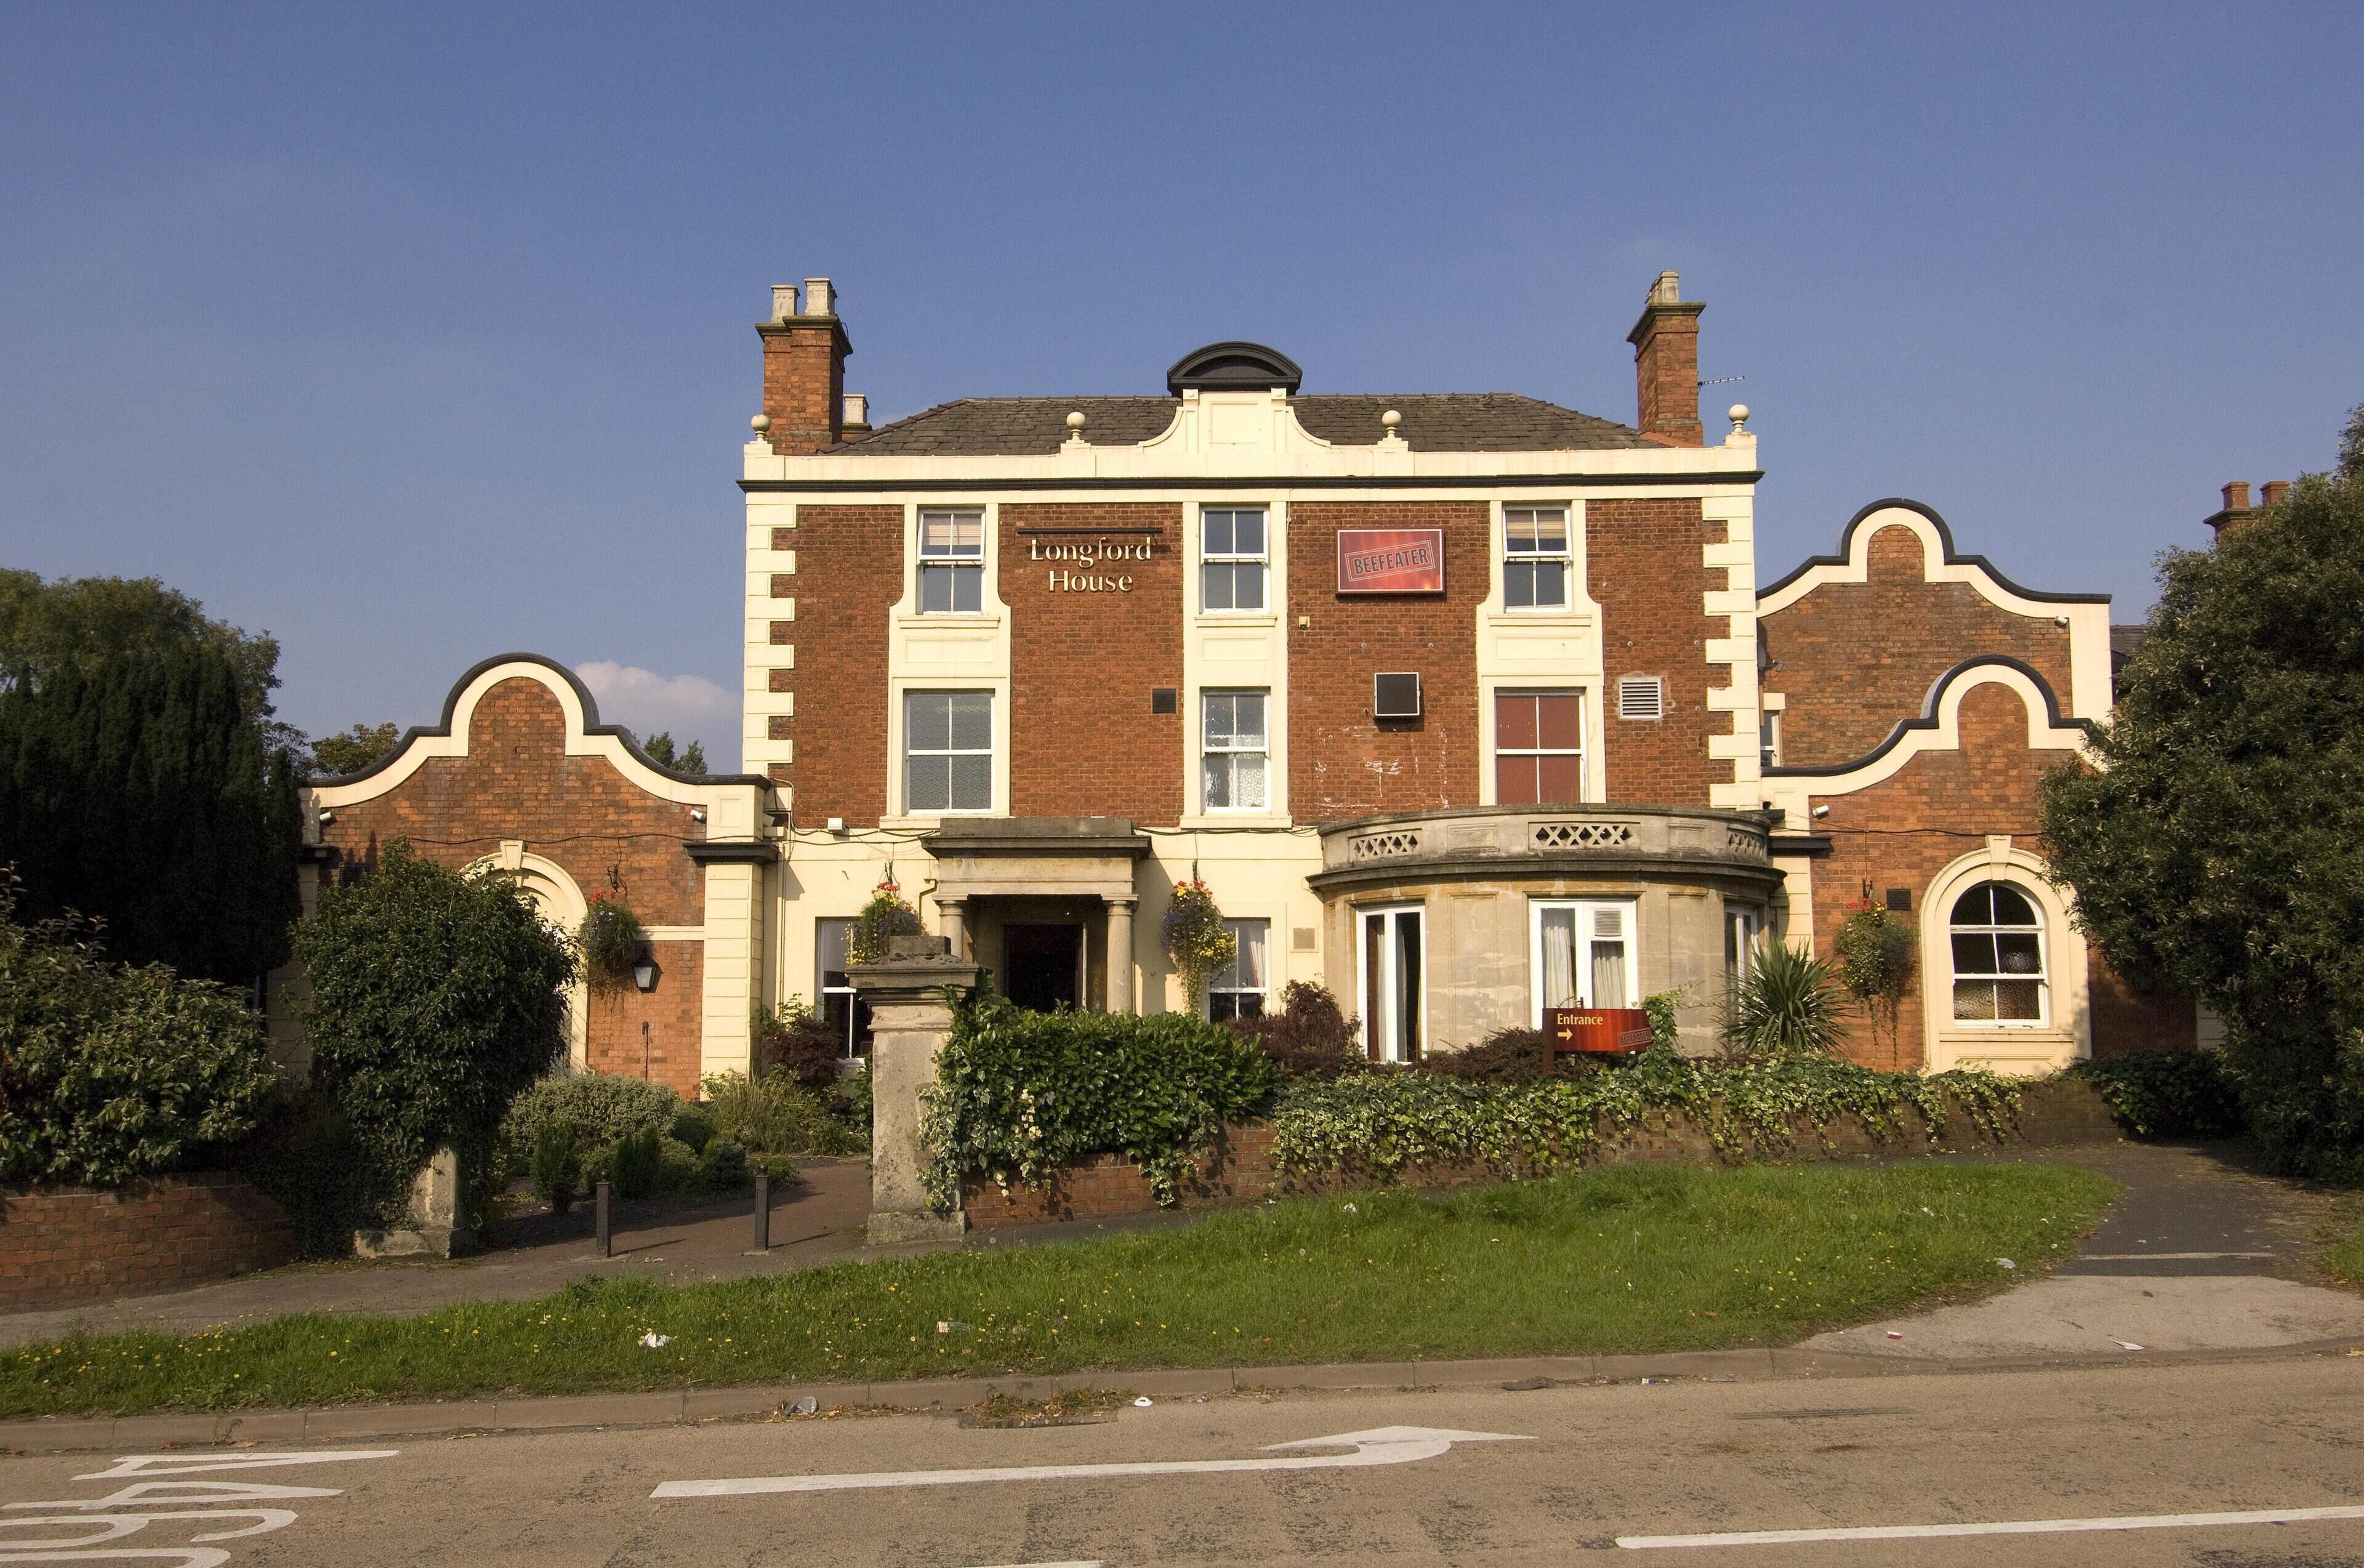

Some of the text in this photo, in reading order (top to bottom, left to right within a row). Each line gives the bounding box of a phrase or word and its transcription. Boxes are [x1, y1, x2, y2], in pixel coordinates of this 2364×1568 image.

[1031, 536, 1151, 568] Longford
[1354, 549, 1428, 574] BEEFEATER
[1048, 570, 1133, 592] House
[1557, 1013, 1604, 1025] Entrance
